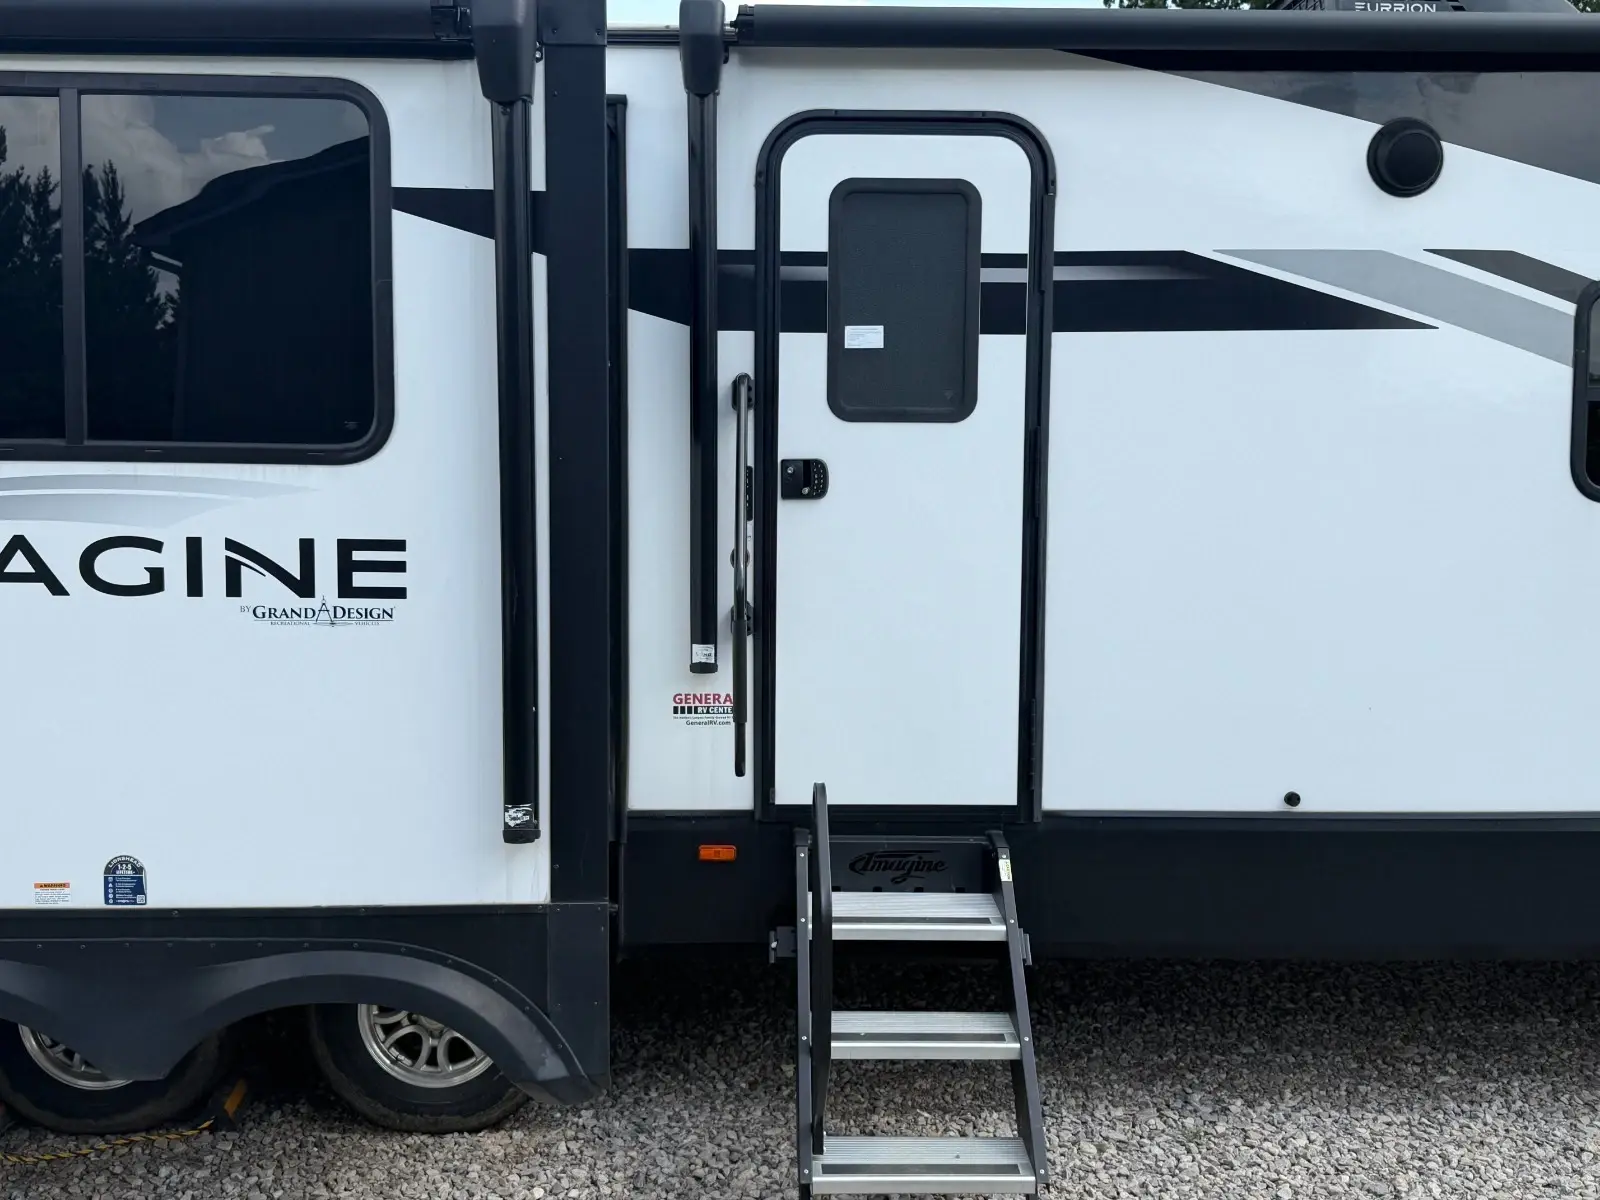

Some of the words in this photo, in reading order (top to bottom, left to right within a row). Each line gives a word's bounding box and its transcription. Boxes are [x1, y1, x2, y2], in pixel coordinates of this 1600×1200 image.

[252, 605, 316, 619] GRAND
[332, 605, 394, 619] DESIGN
[673, 693, 733, 704] GENERA
[697, 706, 709, 714] RV
[709, 706, 733, 714] CENTE
[848, 850, 948, 884] Imagine
